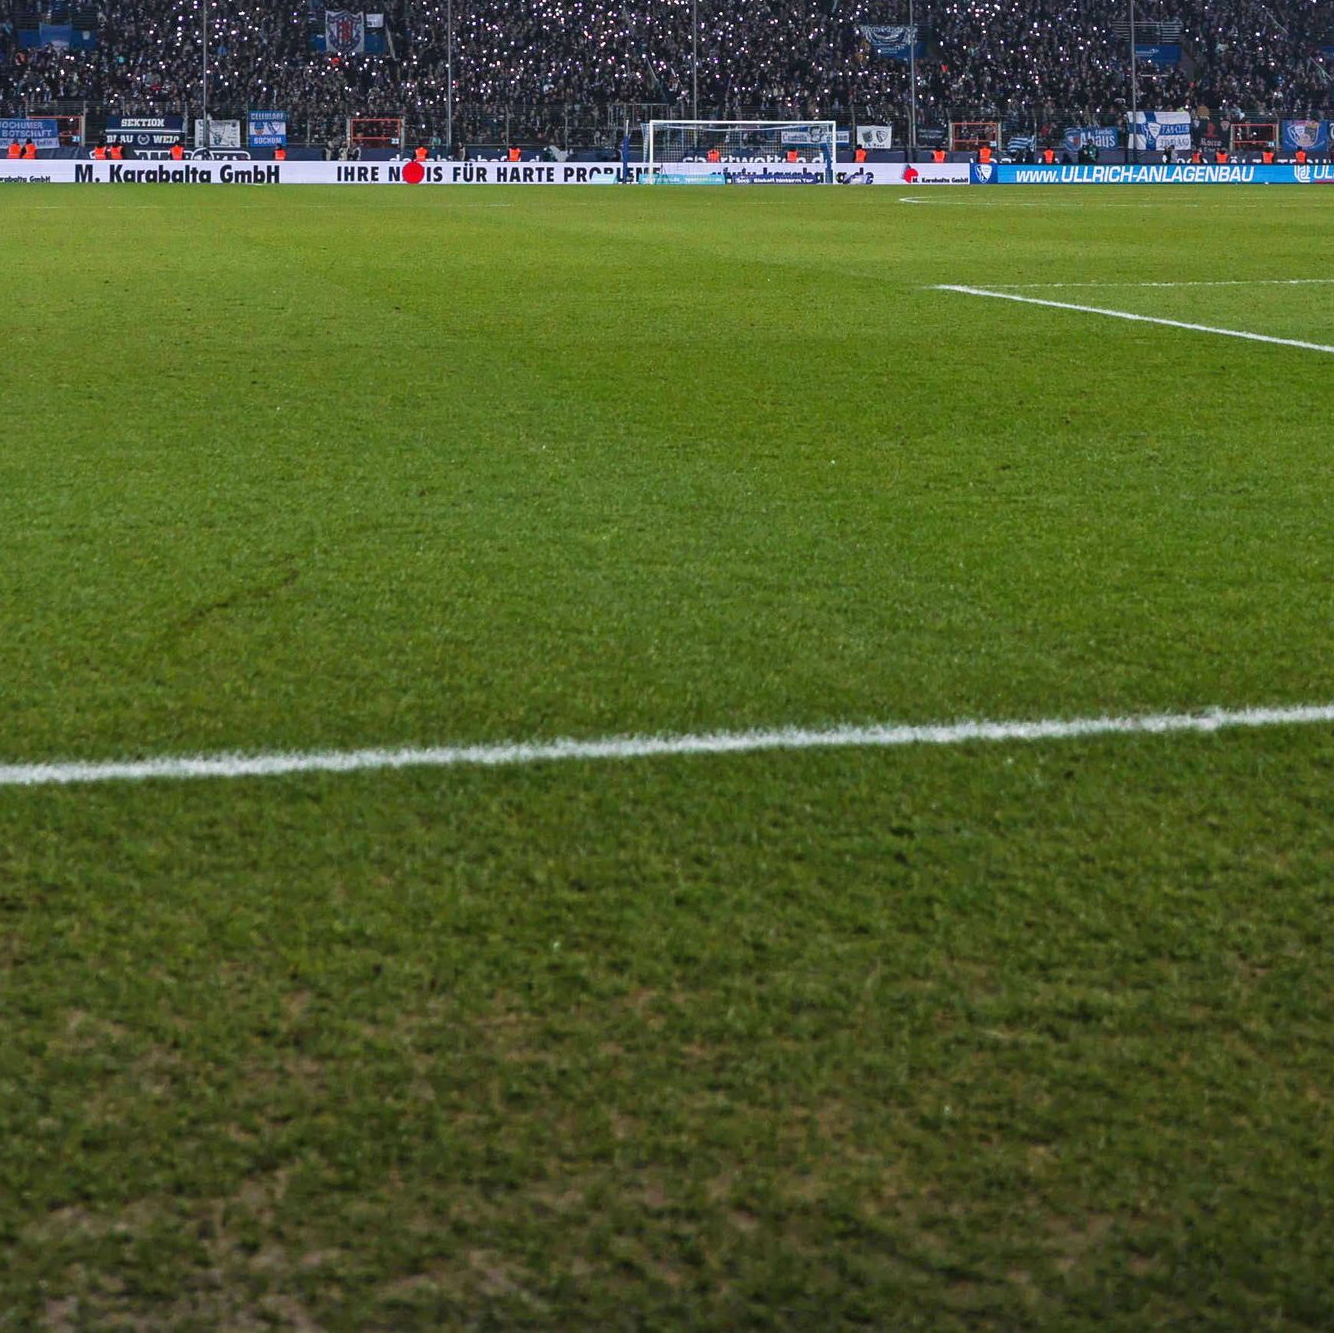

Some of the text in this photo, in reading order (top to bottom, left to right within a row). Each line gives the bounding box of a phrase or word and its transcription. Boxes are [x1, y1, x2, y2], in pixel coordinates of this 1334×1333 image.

[120, 118, 165, 128] SEKTION
[2, 129, 53, 138] BOTSCHAFT
[75, 164, 280, 184] M. Karabalta GmbH
[337, 166, 380, 182] IHRE
[452, 162, 487, 183] FÜR
[497, 167, 554, 183] HARTE
[1016, 165, 1255, 182] www.ULLRICH-ANLAGENBAU
